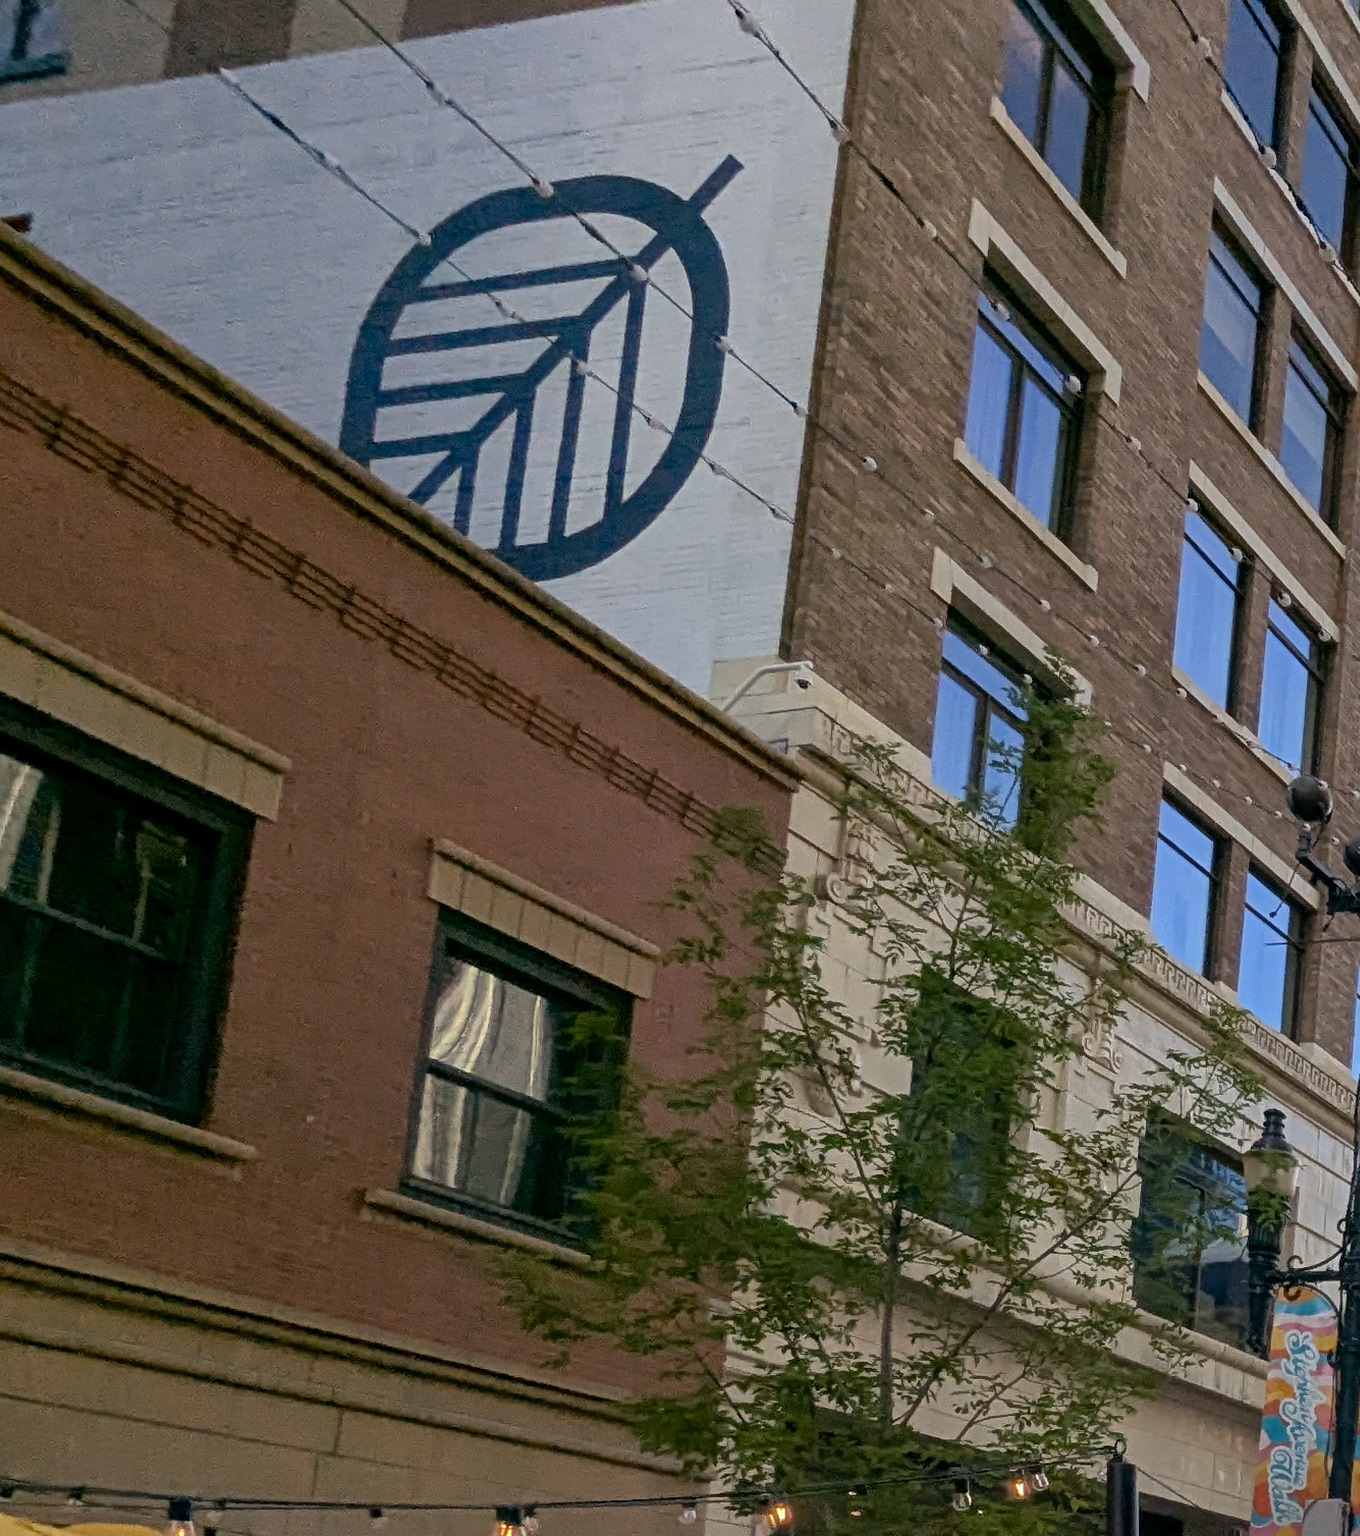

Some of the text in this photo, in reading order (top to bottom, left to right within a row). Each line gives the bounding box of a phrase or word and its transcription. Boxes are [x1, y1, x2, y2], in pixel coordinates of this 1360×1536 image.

[1281, 1333, 1324, 1487] Stephen Avenue
[1270, 1449, 1302, 1523] Walk
